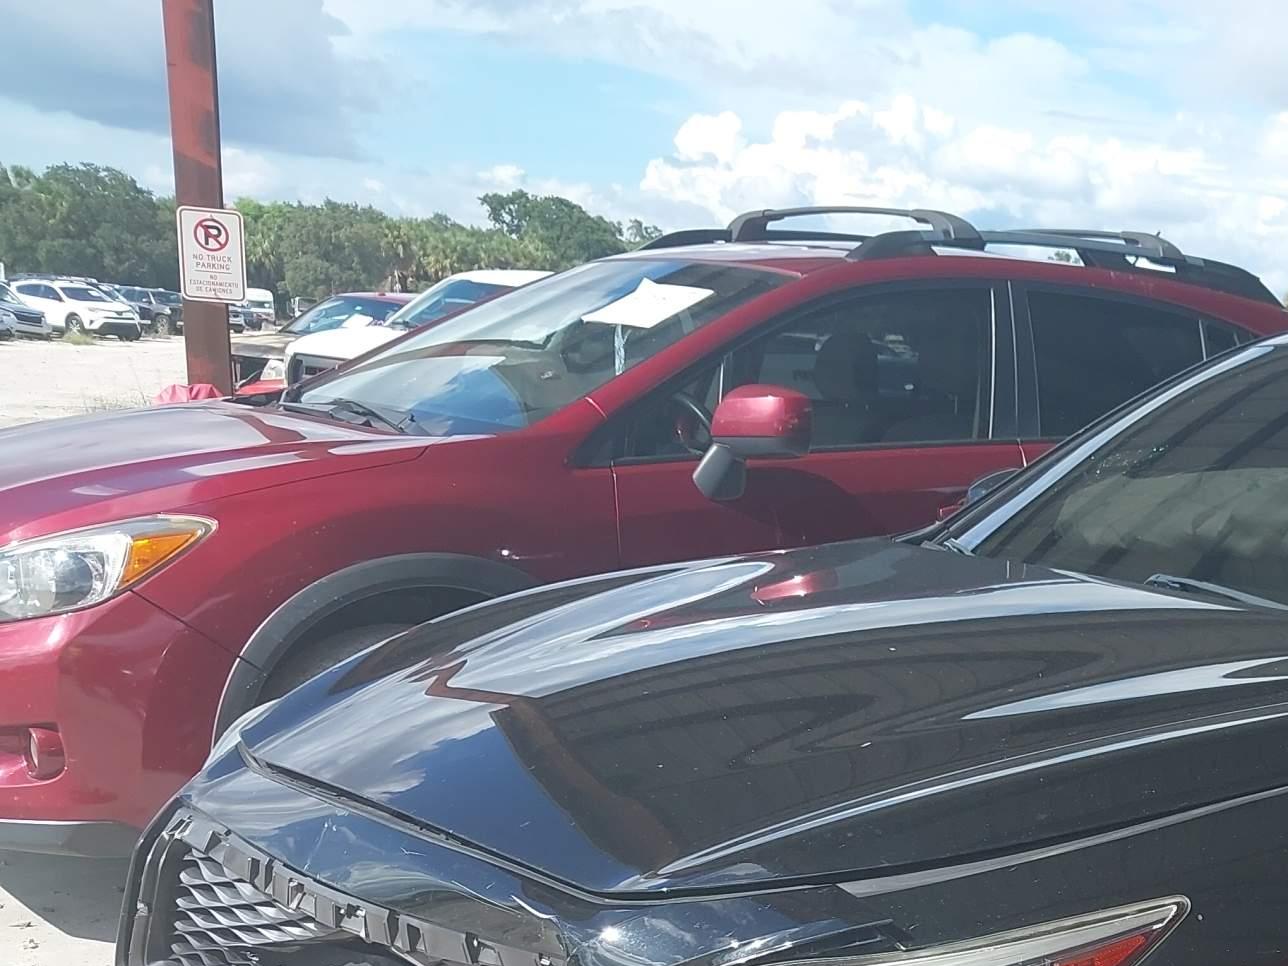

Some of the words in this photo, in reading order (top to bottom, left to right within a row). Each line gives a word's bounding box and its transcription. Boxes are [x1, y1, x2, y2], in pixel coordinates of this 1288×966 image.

[192, 253, 204, 261] NO
[207, 254, 233, 263] TRUCK
[195, 261, 231, 271] PARKING
